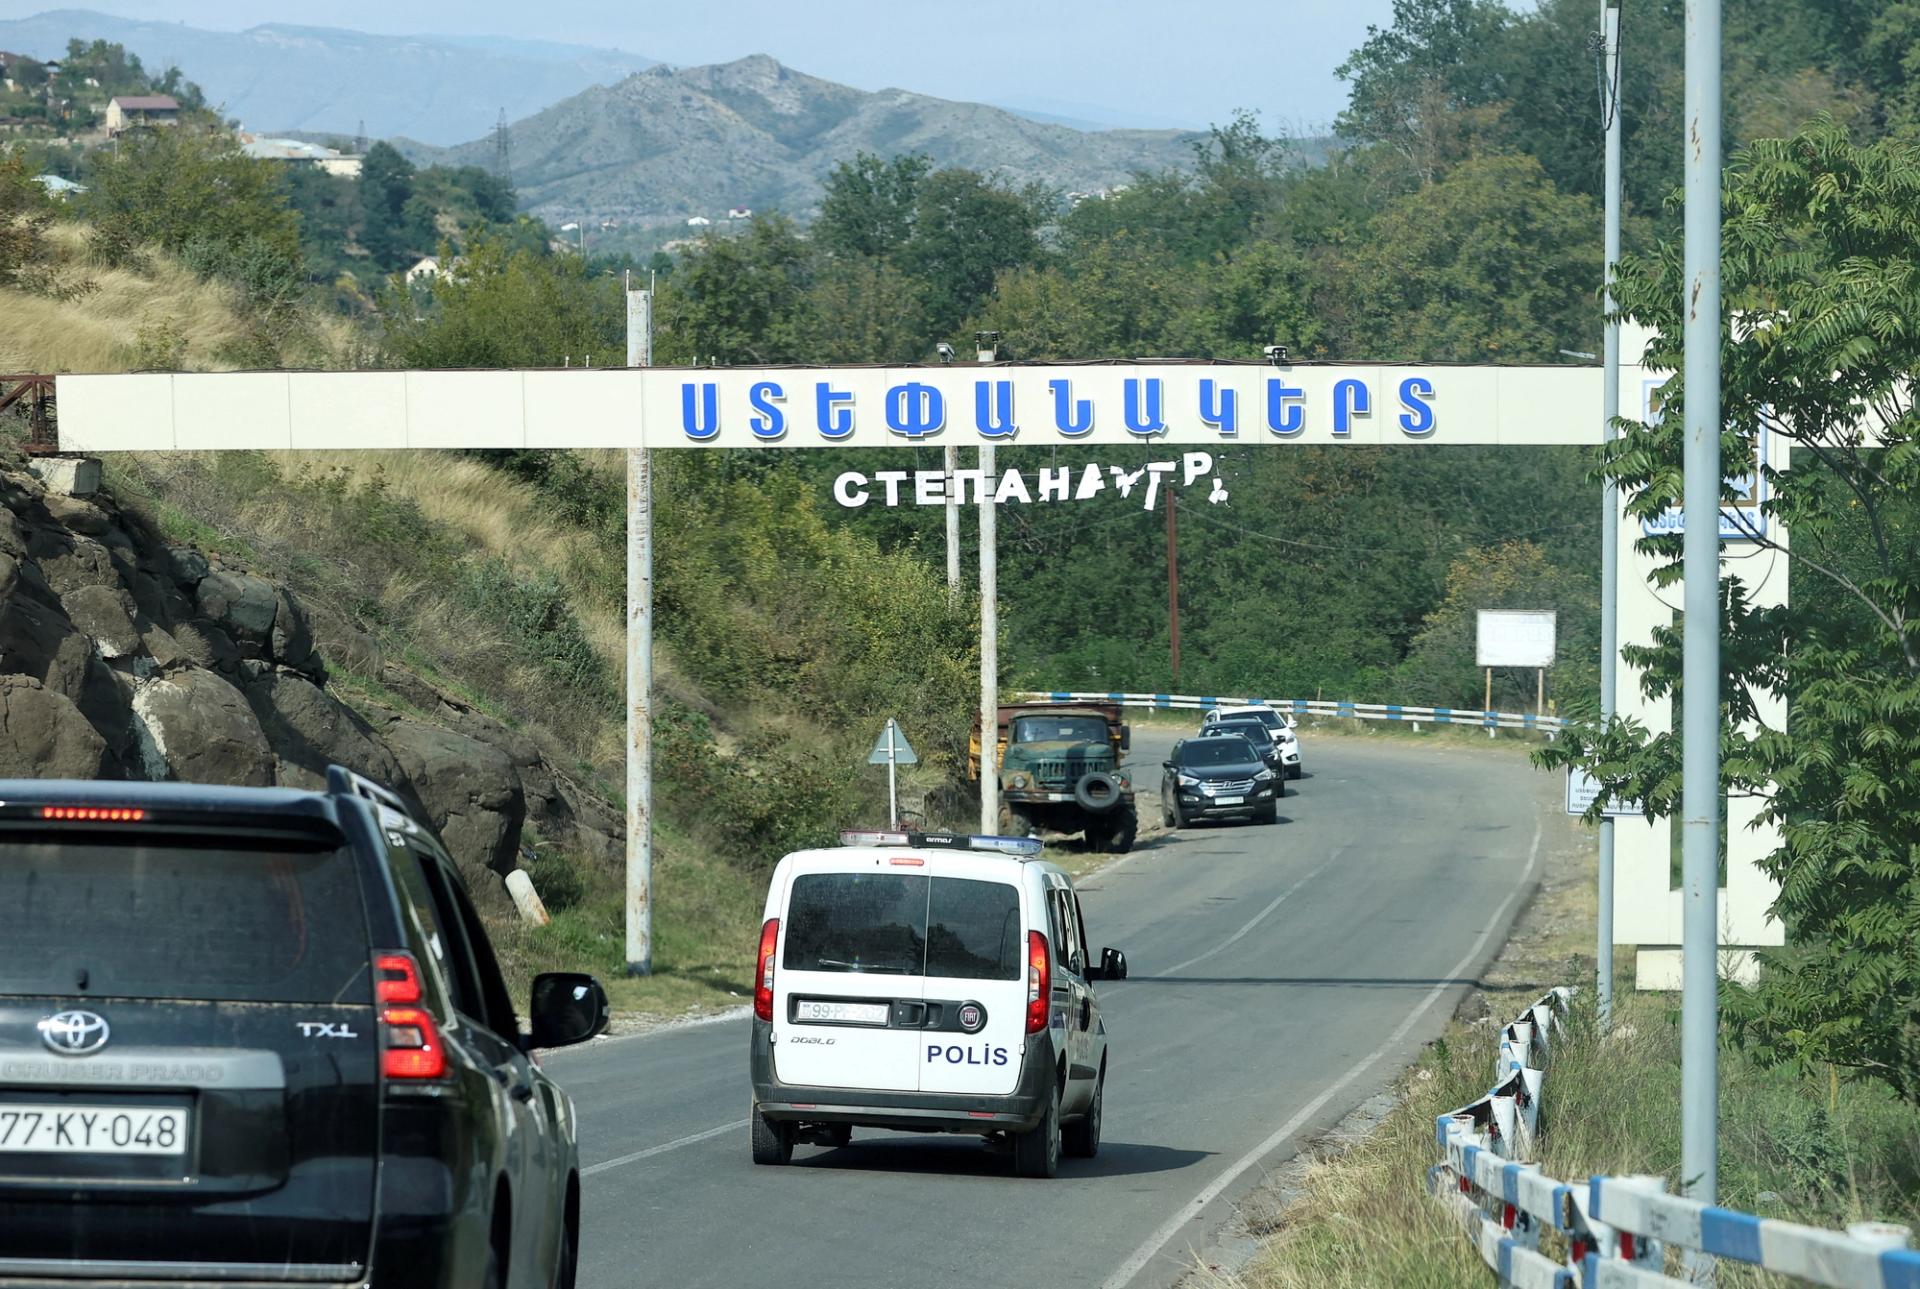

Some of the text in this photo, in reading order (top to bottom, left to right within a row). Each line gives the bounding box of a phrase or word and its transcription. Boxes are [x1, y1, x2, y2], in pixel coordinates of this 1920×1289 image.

[682, 377, 1435, 440] ՍՏԵՓԱՆԱԿԵՐՏ
[964, 1011, 977, 1022] FIAT
[790, 1036, 836, 1046] DOBLO
[2, 1062, 224, 1083] CRUISER PRADO
[1, 1111, 177, 1148] 77-KY-048
